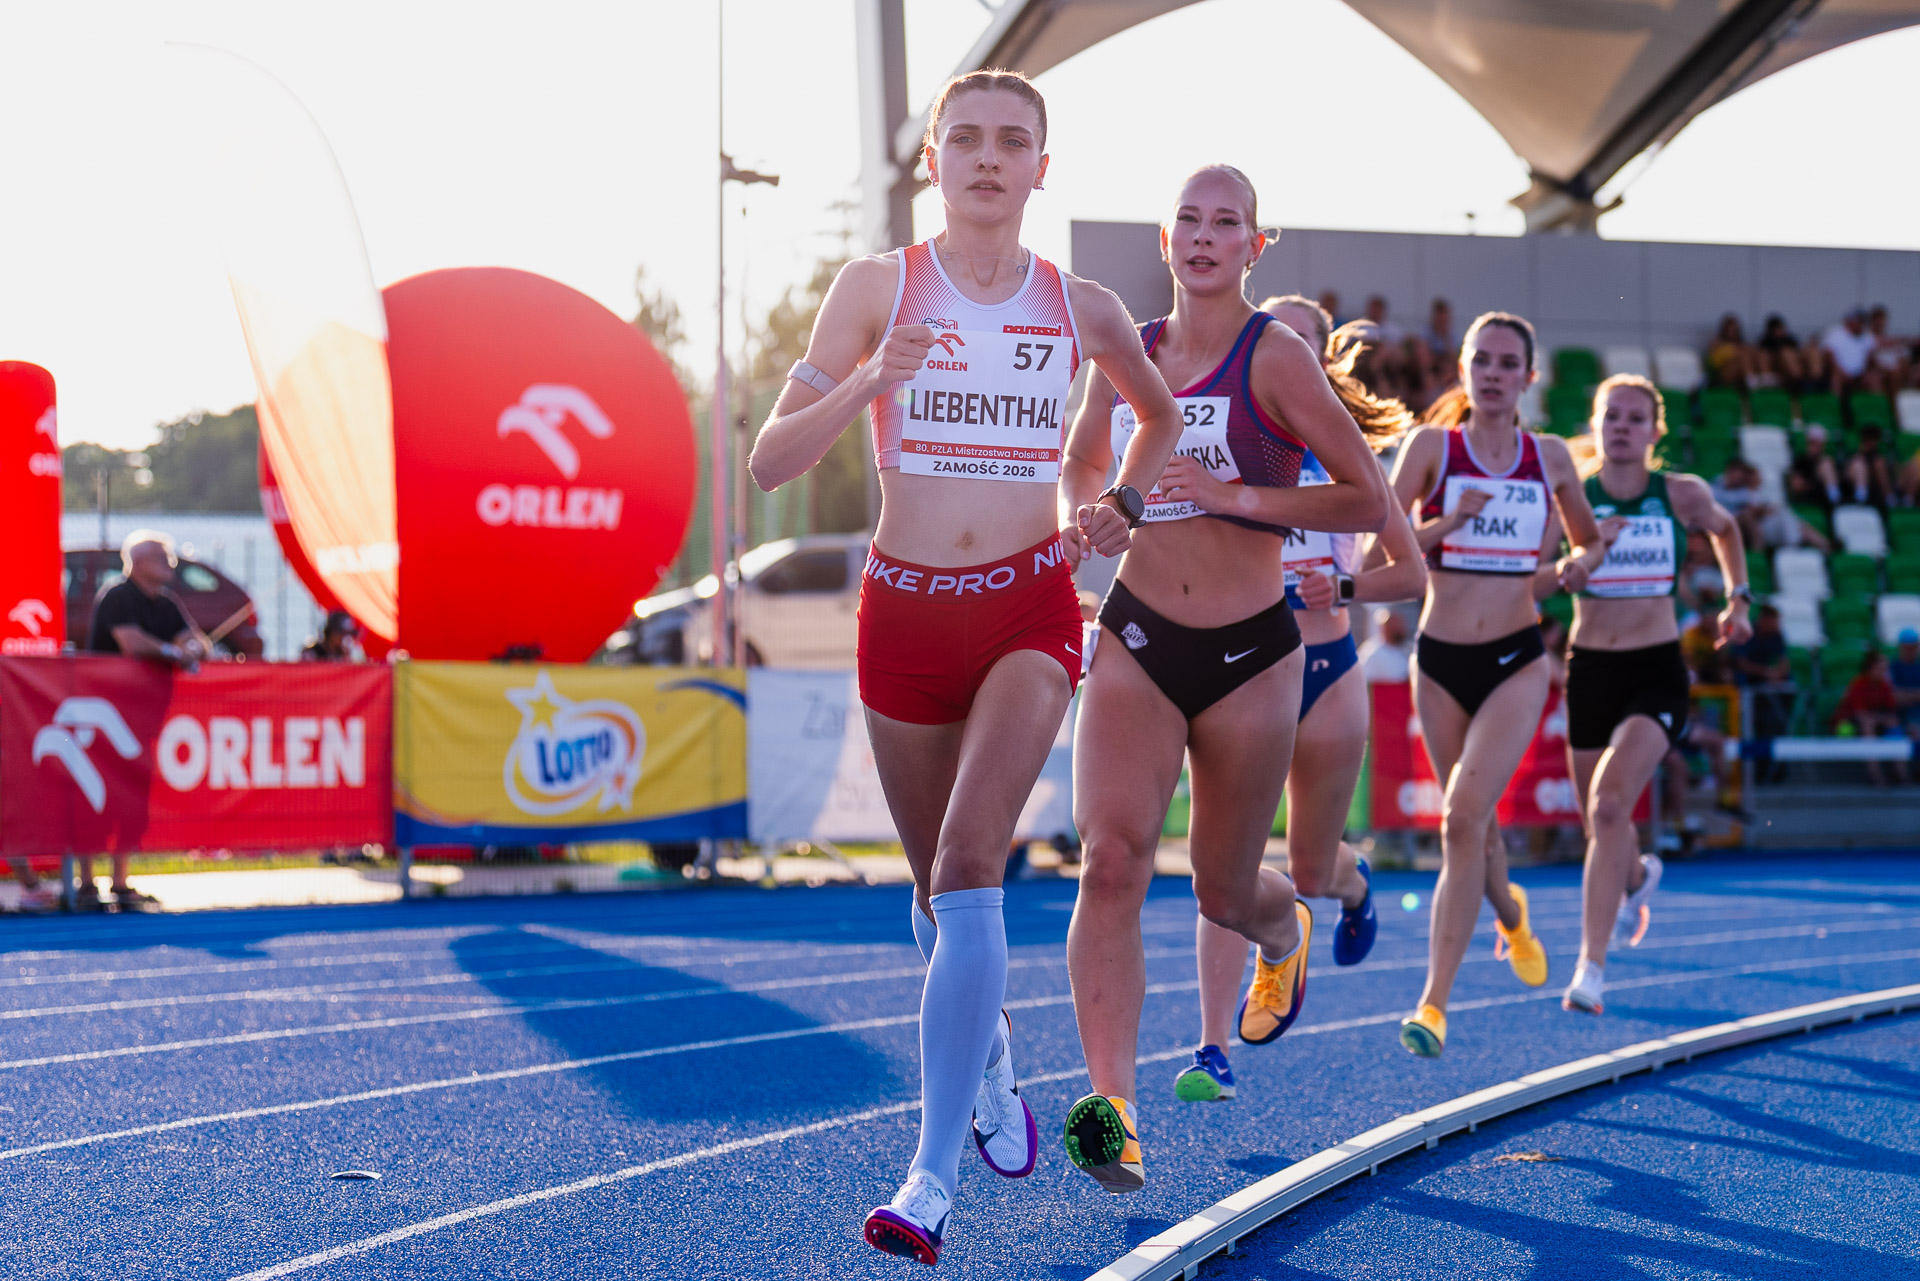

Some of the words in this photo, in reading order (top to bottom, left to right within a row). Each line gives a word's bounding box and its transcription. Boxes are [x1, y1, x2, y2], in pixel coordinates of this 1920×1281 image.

[927, 360, 968, 372] ORLEN
[1013, 342, 1054, 372] 57
[909, 388, 1058, 429] LIEBENTHAL
[915, 442, 930, 453] 80.
[931, 446, 953, 455] PZLA
[955, 446, 1011, 459] Mistrzostwa
[1013, 450, 1037, 460] Polski
[1038, 450, 1050, 460] U20
[932, 460, 999, 476] ZAMOŚĆ
[1002, 465, 1036, 478] 2026
[476, 483, 624, 530] ORLEN
[1504, 485, 1538, 505] 738
[1146, 503, 1189, 519] ZAMOŚĆ
[1473, 516, 1518, 538] RAK
[928, 566, 1016, 596] PRO
[1034, 538, 1065, 575] NI
[157, 714, 366, 792] ORLEN
[534, 730, 615, 787] LOTTO
